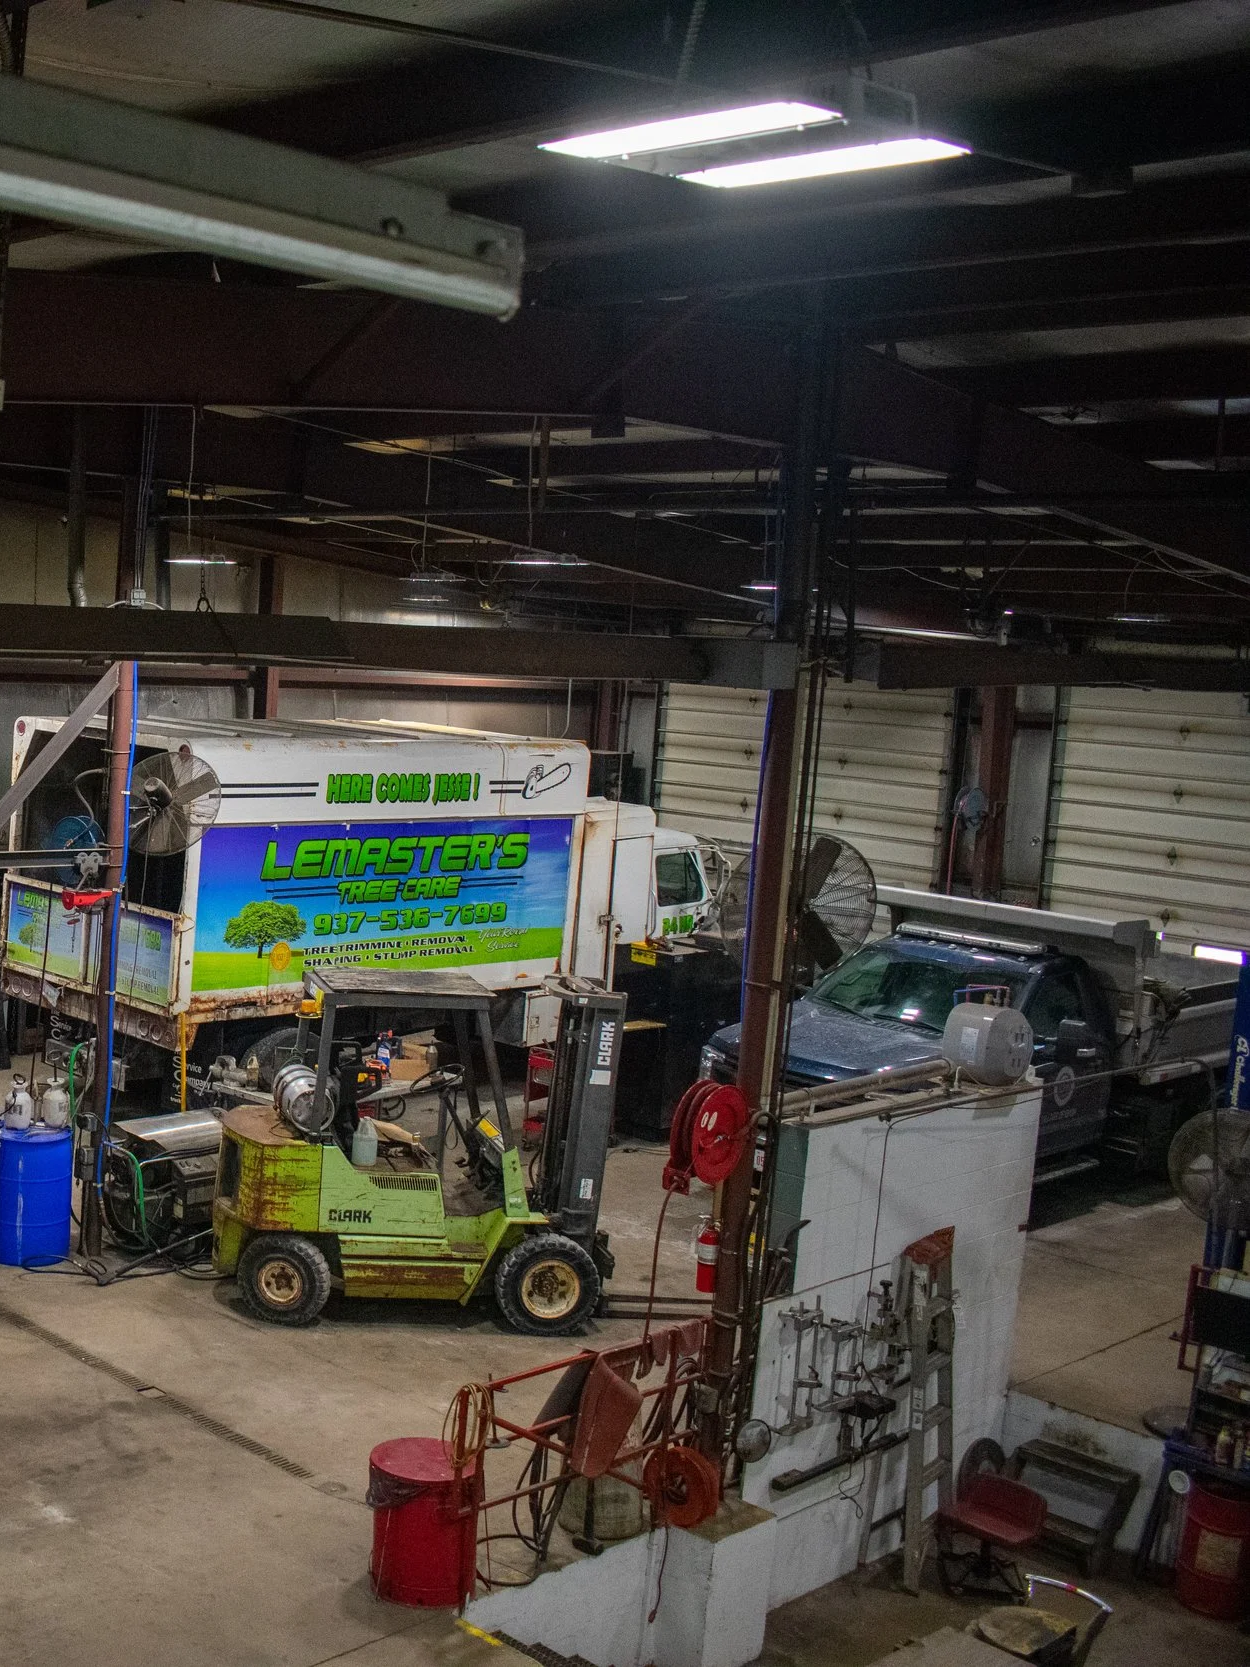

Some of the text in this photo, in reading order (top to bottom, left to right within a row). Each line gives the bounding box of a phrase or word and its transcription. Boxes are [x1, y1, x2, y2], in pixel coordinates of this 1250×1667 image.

[326, 773, 373, 804] HERE
[376, 772, 431, 803] COMES
[260, 832, 531, 881] LEMASTER'S
[337, 876, 462, 904] TREE CARE
[313, 902, 508, 936] 937-536-7699
[597, 1021, 616, 1066] CLARK
[329, 1209, 373, 1223] CLARK
